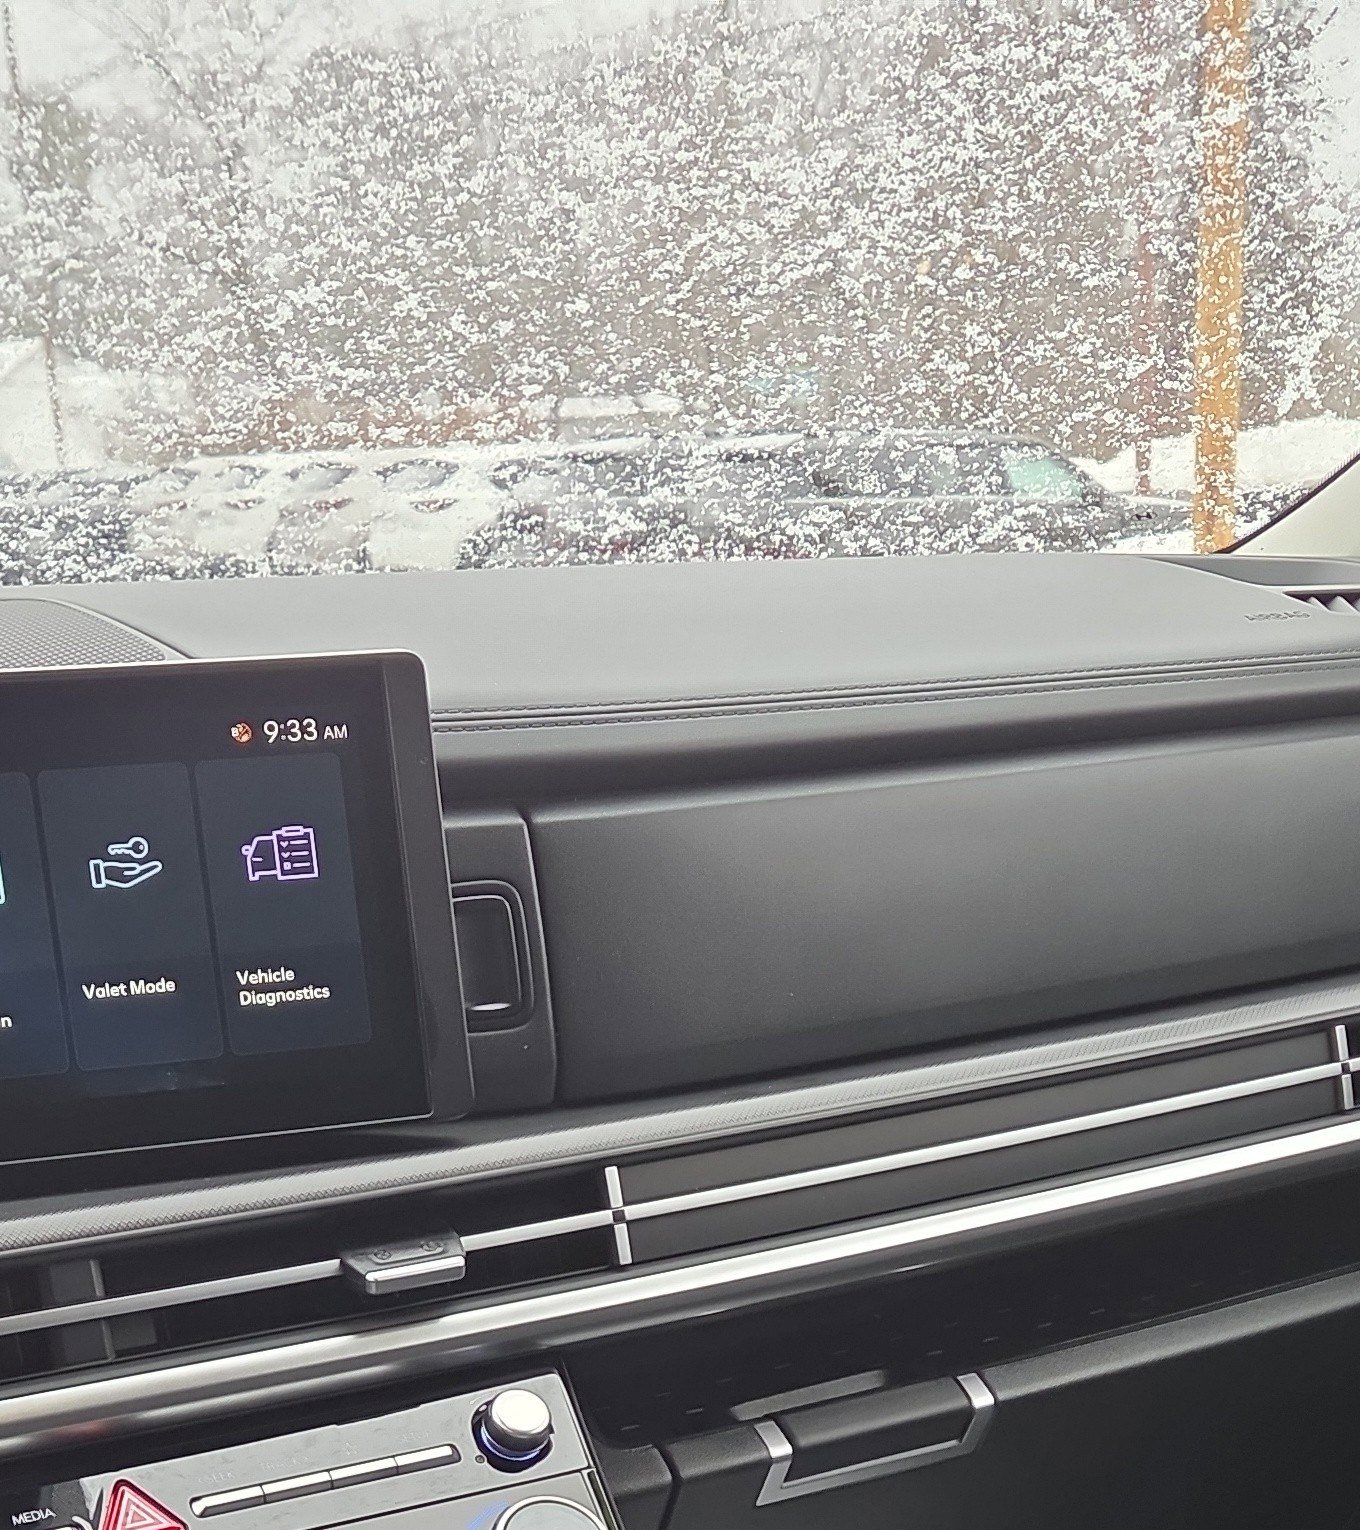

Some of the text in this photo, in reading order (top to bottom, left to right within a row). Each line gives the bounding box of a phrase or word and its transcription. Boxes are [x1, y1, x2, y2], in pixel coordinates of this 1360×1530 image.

[263, 718, 348, 743] 9:33 AM
[236, 966, 295, 986] Vehicle
[81, 977, 176, 1000] Valet Mode
[239, 984, 331, 1007] Diagnostics
[11, 1508, 57, 1526] MEDIA
